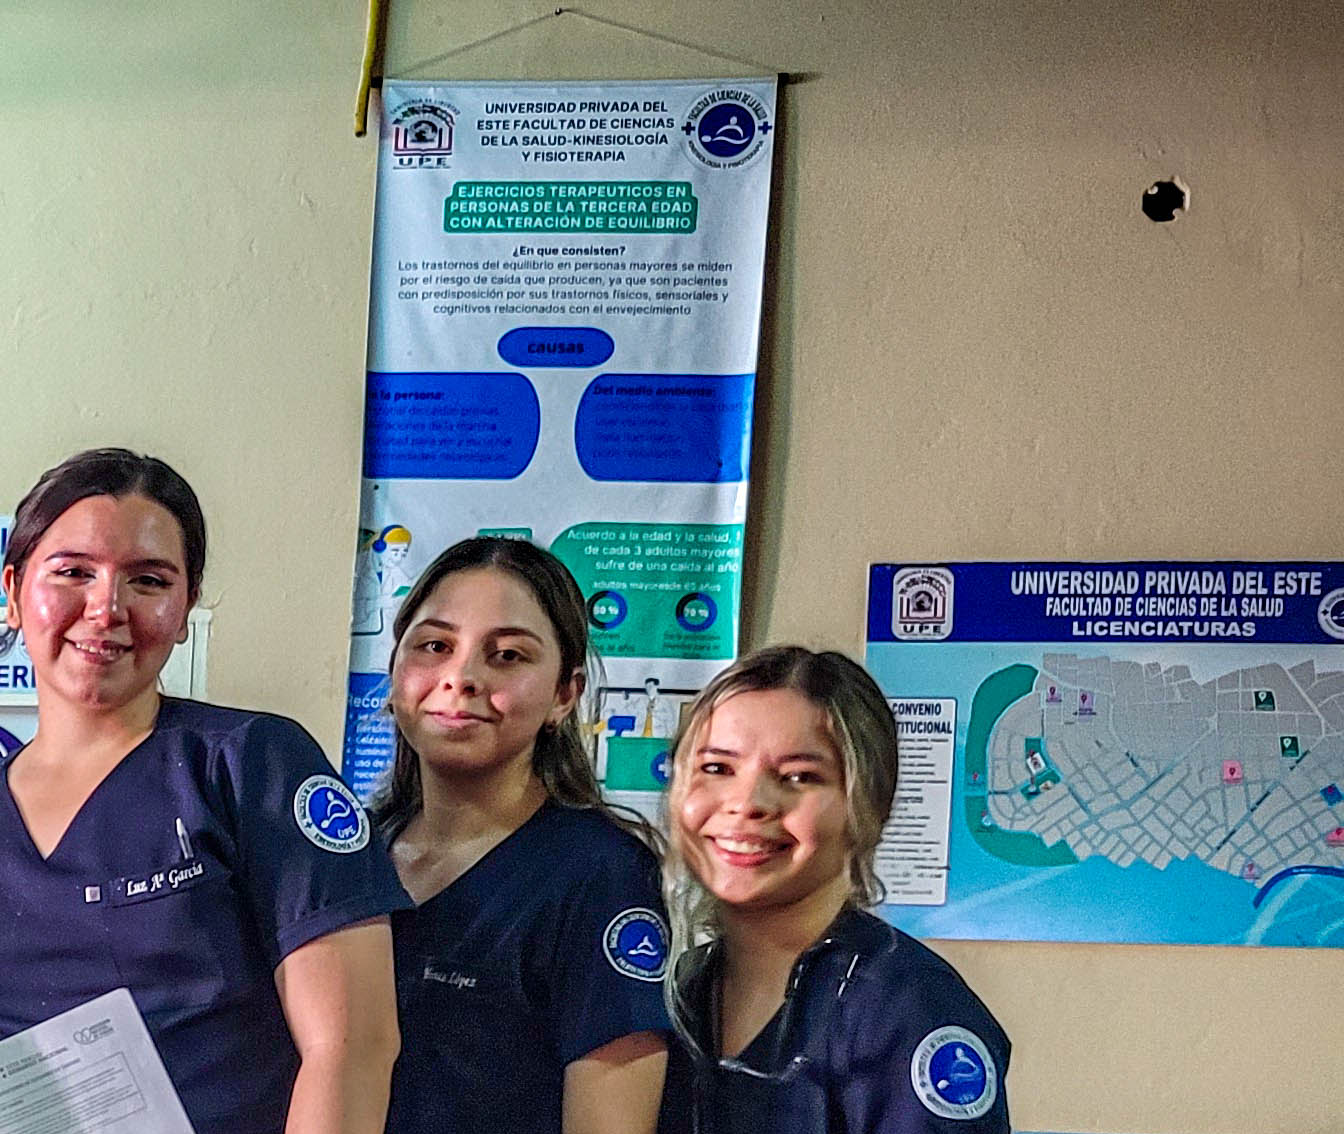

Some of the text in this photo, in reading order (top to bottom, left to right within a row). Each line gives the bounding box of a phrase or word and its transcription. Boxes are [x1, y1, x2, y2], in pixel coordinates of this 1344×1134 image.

[485, 101, 668, 114] UNIVERSIDAD PRIVADA DEL
[477, 118, 675, 130] ESTE FACULTAD DE CIENCIAS
[481, 132, 668, 146] DE LA SALUD-KINESIOLOGÍA
[521, 151, 626, 162] Y FISIOTERAPIA
[458, 185, 686, 198] EJERCICIOS TERAPEUTICOS EN
[450, 200, 692, 213] PERSONAS DE LA TERCERA EDAD
[449, 215, 691, 229] CON ALTERACIÓN DE EQUILIBRIO
[512, 245, 626, 258] ¿En que consisten?
[398, 260, 733, 273] Los trastornos del equilibrio en personas mayores se miden
[399, 276, 419, 287] por
[422, 275, 432, 285] el
[435, 275, 470, 287] riesgo
[473, 275, 488, 285] de
[524, 276, 546, 286] que
[548, 275, 605, 287] producen,
[608, 276, 624, 287] ya
[625, 277, 647, 287] que
[649, 277, 670, 286] son
[672, 276, 728, 287] pacientes
[398, 290, 418, 299] con
[421, 288, 504, 301] predisposición
[506, 289, 526, 301] por
[528, 290, 548, 299] sus
[551, 289, 609, 299] trastornos
[655, 289, 719, 300] sensoriales
[722, 292, 729, 303] y
[433, 303, 691, 316] cognitivos relacionados con el envejecimiento
[527, 340, 585, 354] causas
[568, 529, 616, 540] Acuerdo
[618, 531, 626, 540] a
[629, 530, 639, 540] la
[642, 530, 672, 541] edad
[675, 533, 682, 543] y
[685, 531, 695, 542] la
[584, 545, 599, 555] de
[603, 546, 630, 556] cada
[634, 546, 642, 556] 3
[645, 546, 687, 557] adultos
[595, 560, 625, 571] sufre
[628, 560, 644, 571] de
[646, 562, 667, 571] una
[1011, 571, 1322, 595] UNIVERSIDAD PRIVADA DEL ESTE
[1045, 597, 1284, 617] FACULTAD DE CIENCIAS DE LA SALUD
[902, 625, 942, 633] UPE
[1072, 621, 1256, 637] LICENCIATURAS
[892, 702, 942, 716] CONVENIO
[896, 721, 953, 735] TITUCIONAL
[126, 880, 149, 897] Luz
